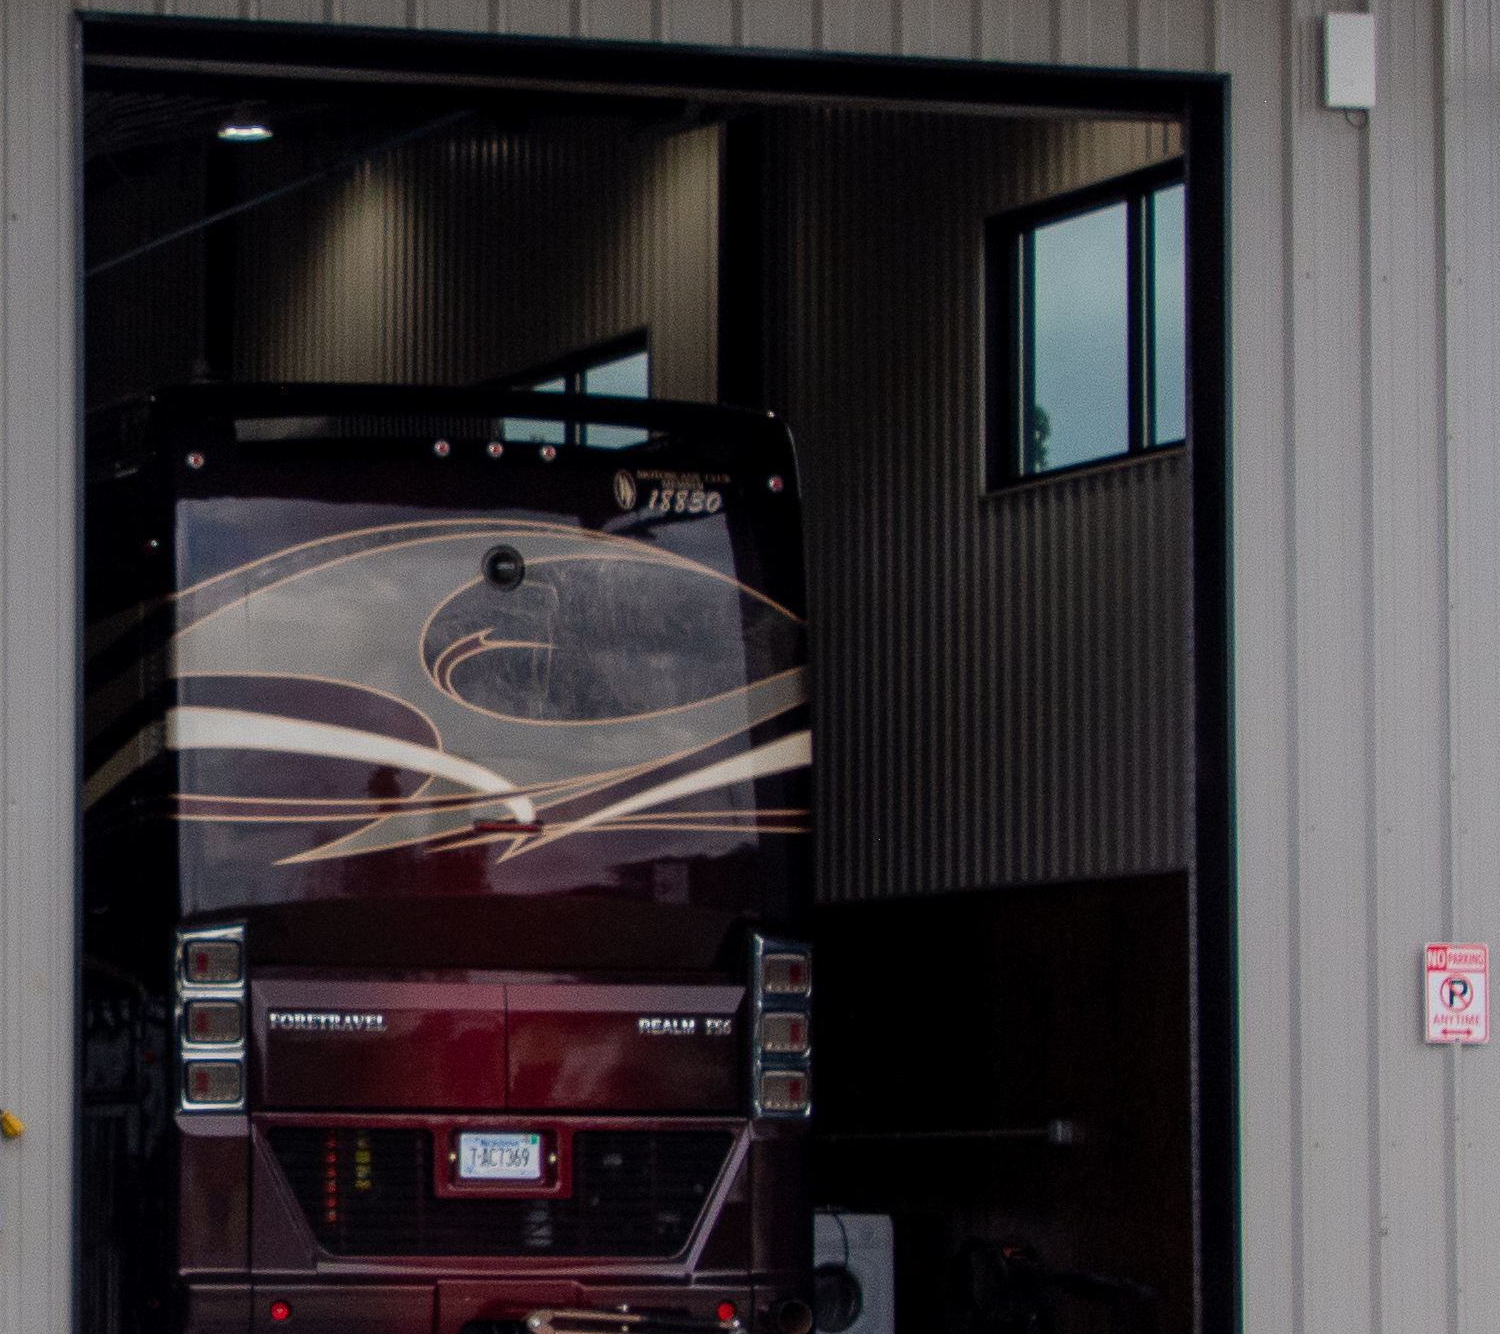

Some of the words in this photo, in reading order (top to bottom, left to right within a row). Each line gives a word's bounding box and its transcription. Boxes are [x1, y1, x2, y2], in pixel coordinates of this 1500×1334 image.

[1427, 950, 1446, 968] NO
[1448, 953, 1484, 965] PARKING
[269, 1013, 387, 1031] FORETRAVEL
[639, 1018, 695, 1034] REALM
[1433, 1013, 1479, 1024] ANYTIME
